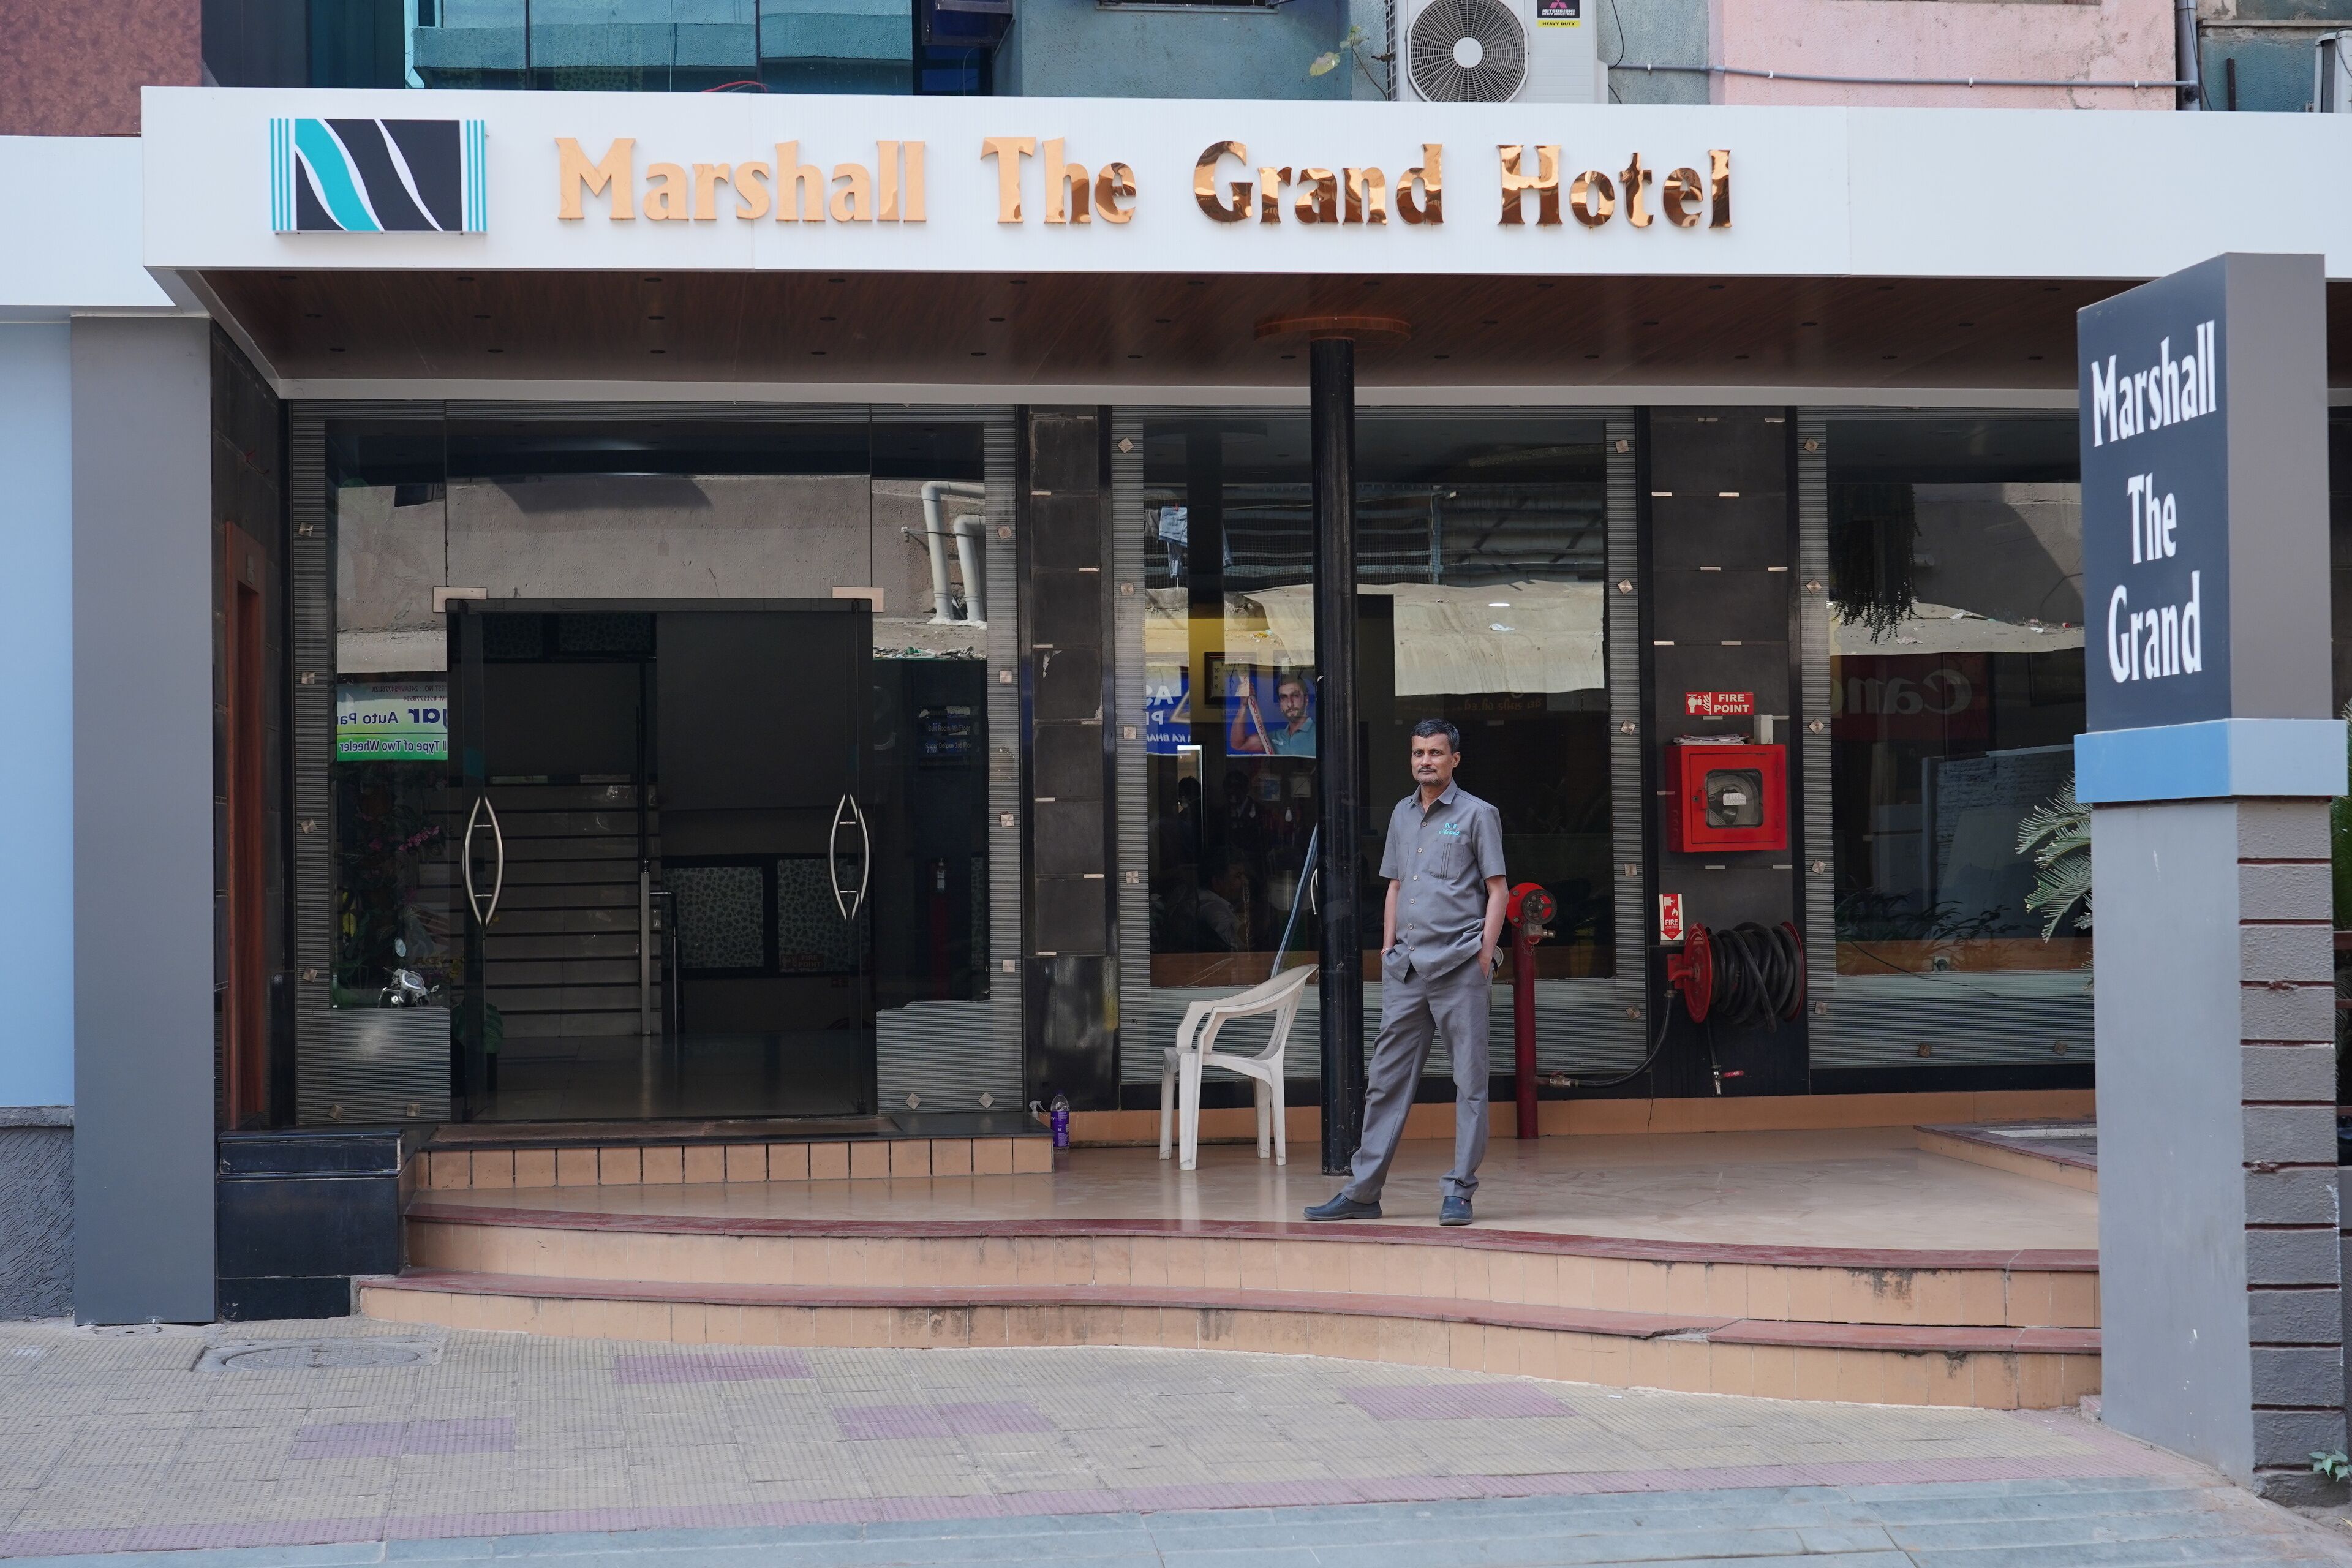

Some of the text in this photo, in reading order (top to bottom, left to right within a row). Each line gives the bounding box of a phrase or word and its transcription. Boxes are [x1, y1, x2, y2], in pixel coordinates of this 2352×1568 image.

[555, 137, 1732, 228] Marshall The Grand Hotel
[2091, 320, 2217, 447] Marshall
[2127, 472, 2177, 564] The
[2108, 570, 2202, 684] Grand
[1714, 704, 1750, 713] POINT
